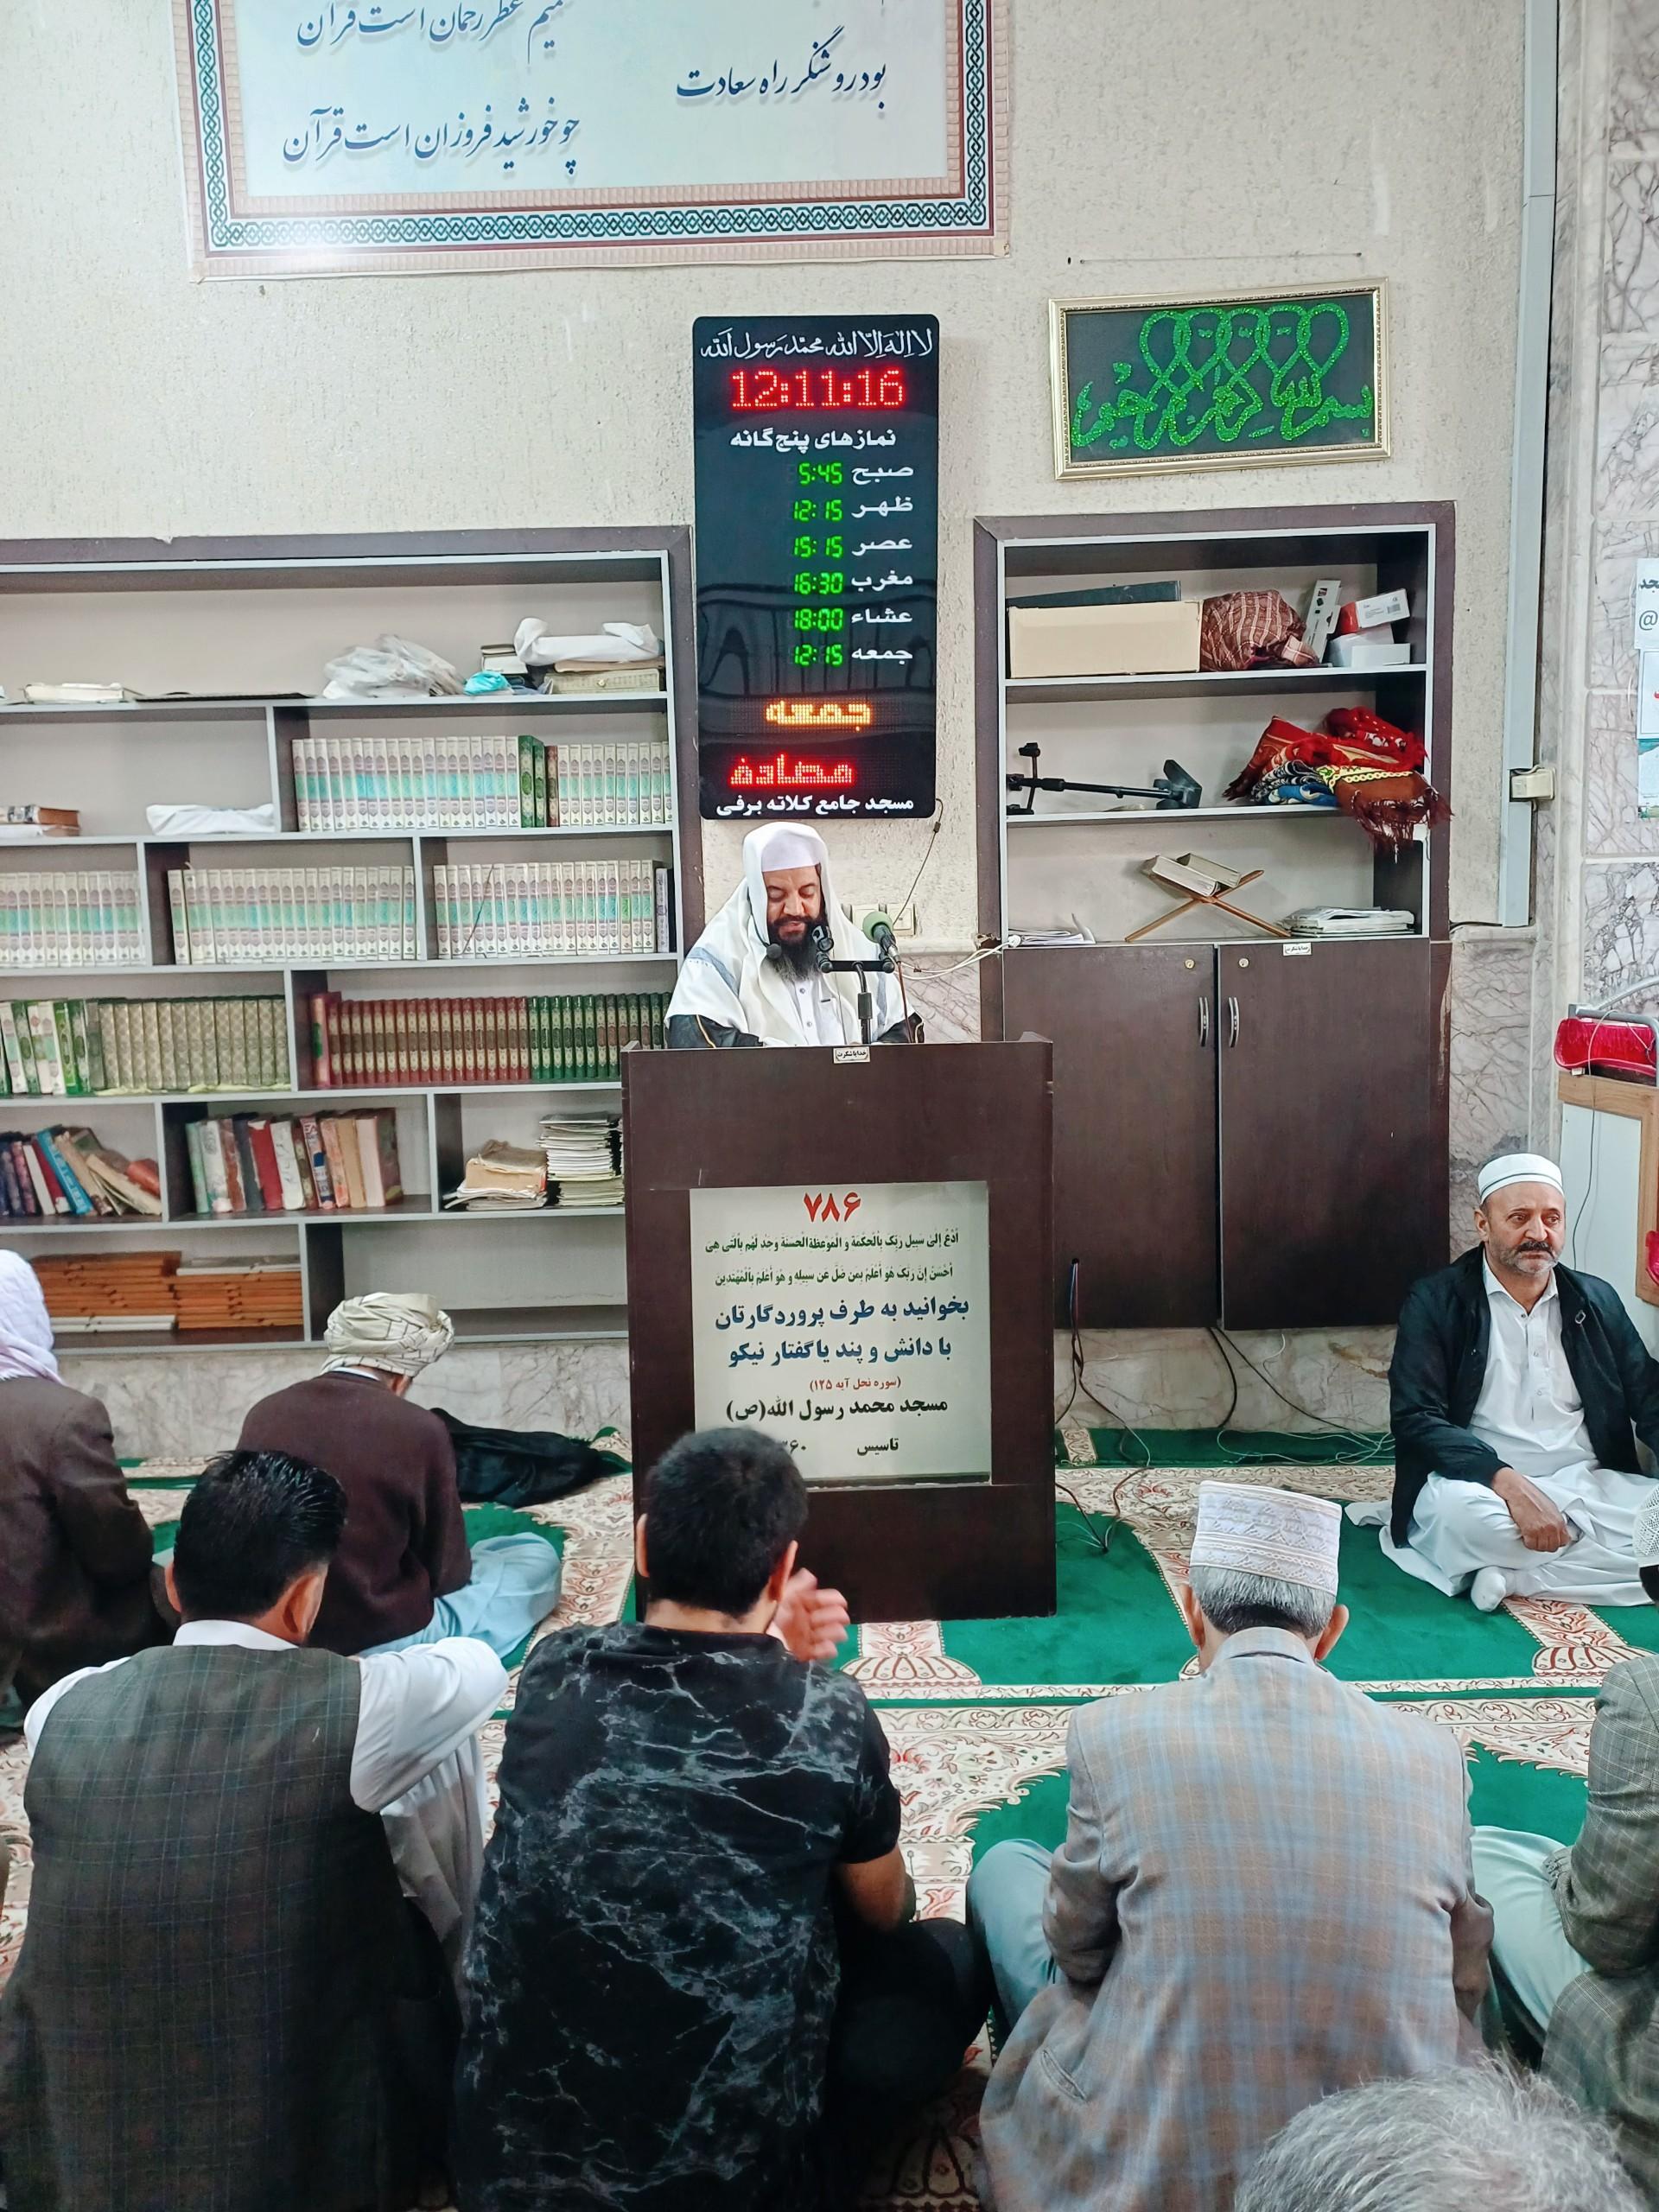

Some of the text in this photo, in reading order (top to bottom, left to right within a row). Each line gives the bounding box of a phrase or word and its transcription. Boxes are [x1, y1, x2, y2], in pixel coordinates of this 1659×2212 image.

[359, 6, 425, 34] است
[429, 1, 484, 42] رحمان
[677, 24, 887, 110] بود روشنگر راه سعادت
[283, 96, 581, 175] چو خورشید فروزان است قرآن
[910, 327, 933, 357] لا
[732, 370, 904, 407] 12:11:16
[814, 429, 897, 449] نمازهای
[798, 463, 914, 486] صبح 5:45
[851, 495, 914, 518] ظهر
[851, 537, 913, 556] عصر
[793, 569, 914, 595] مغرب 16:30
[794, 607, 913, 631] عشاء 18:00
[851, 647, 914, 665] جمعه
[766, 700, 872, 732] جمعه
[730, 753, 853, 785] مصادف
[716, 795, 914, 817] مسجد جامع کلاته برفی
[803, 1192, 861, 1223] ۷۸۶
[715, 1295, 969, 1330] بخوانید به طرف پروردگارتان
[728, 1341, 765, 1368] نیکو
[772, 1339, 814, 1366] گفتار
[836, 1341, 862, 1364] پند
[868, 1346, 878, 1363] و
[884, 1337, 933, 1363] دانش
[938, 1337, 951, 1361] با
[853, 1377, 871, 1390] نحل
[799, 1399, 844, 1421] رسول
[849, 1397, 895, 1414] محمد
[899, 1398, 949, 1416] مسجد
[856, 1437, 899, 1456] تاسیس
